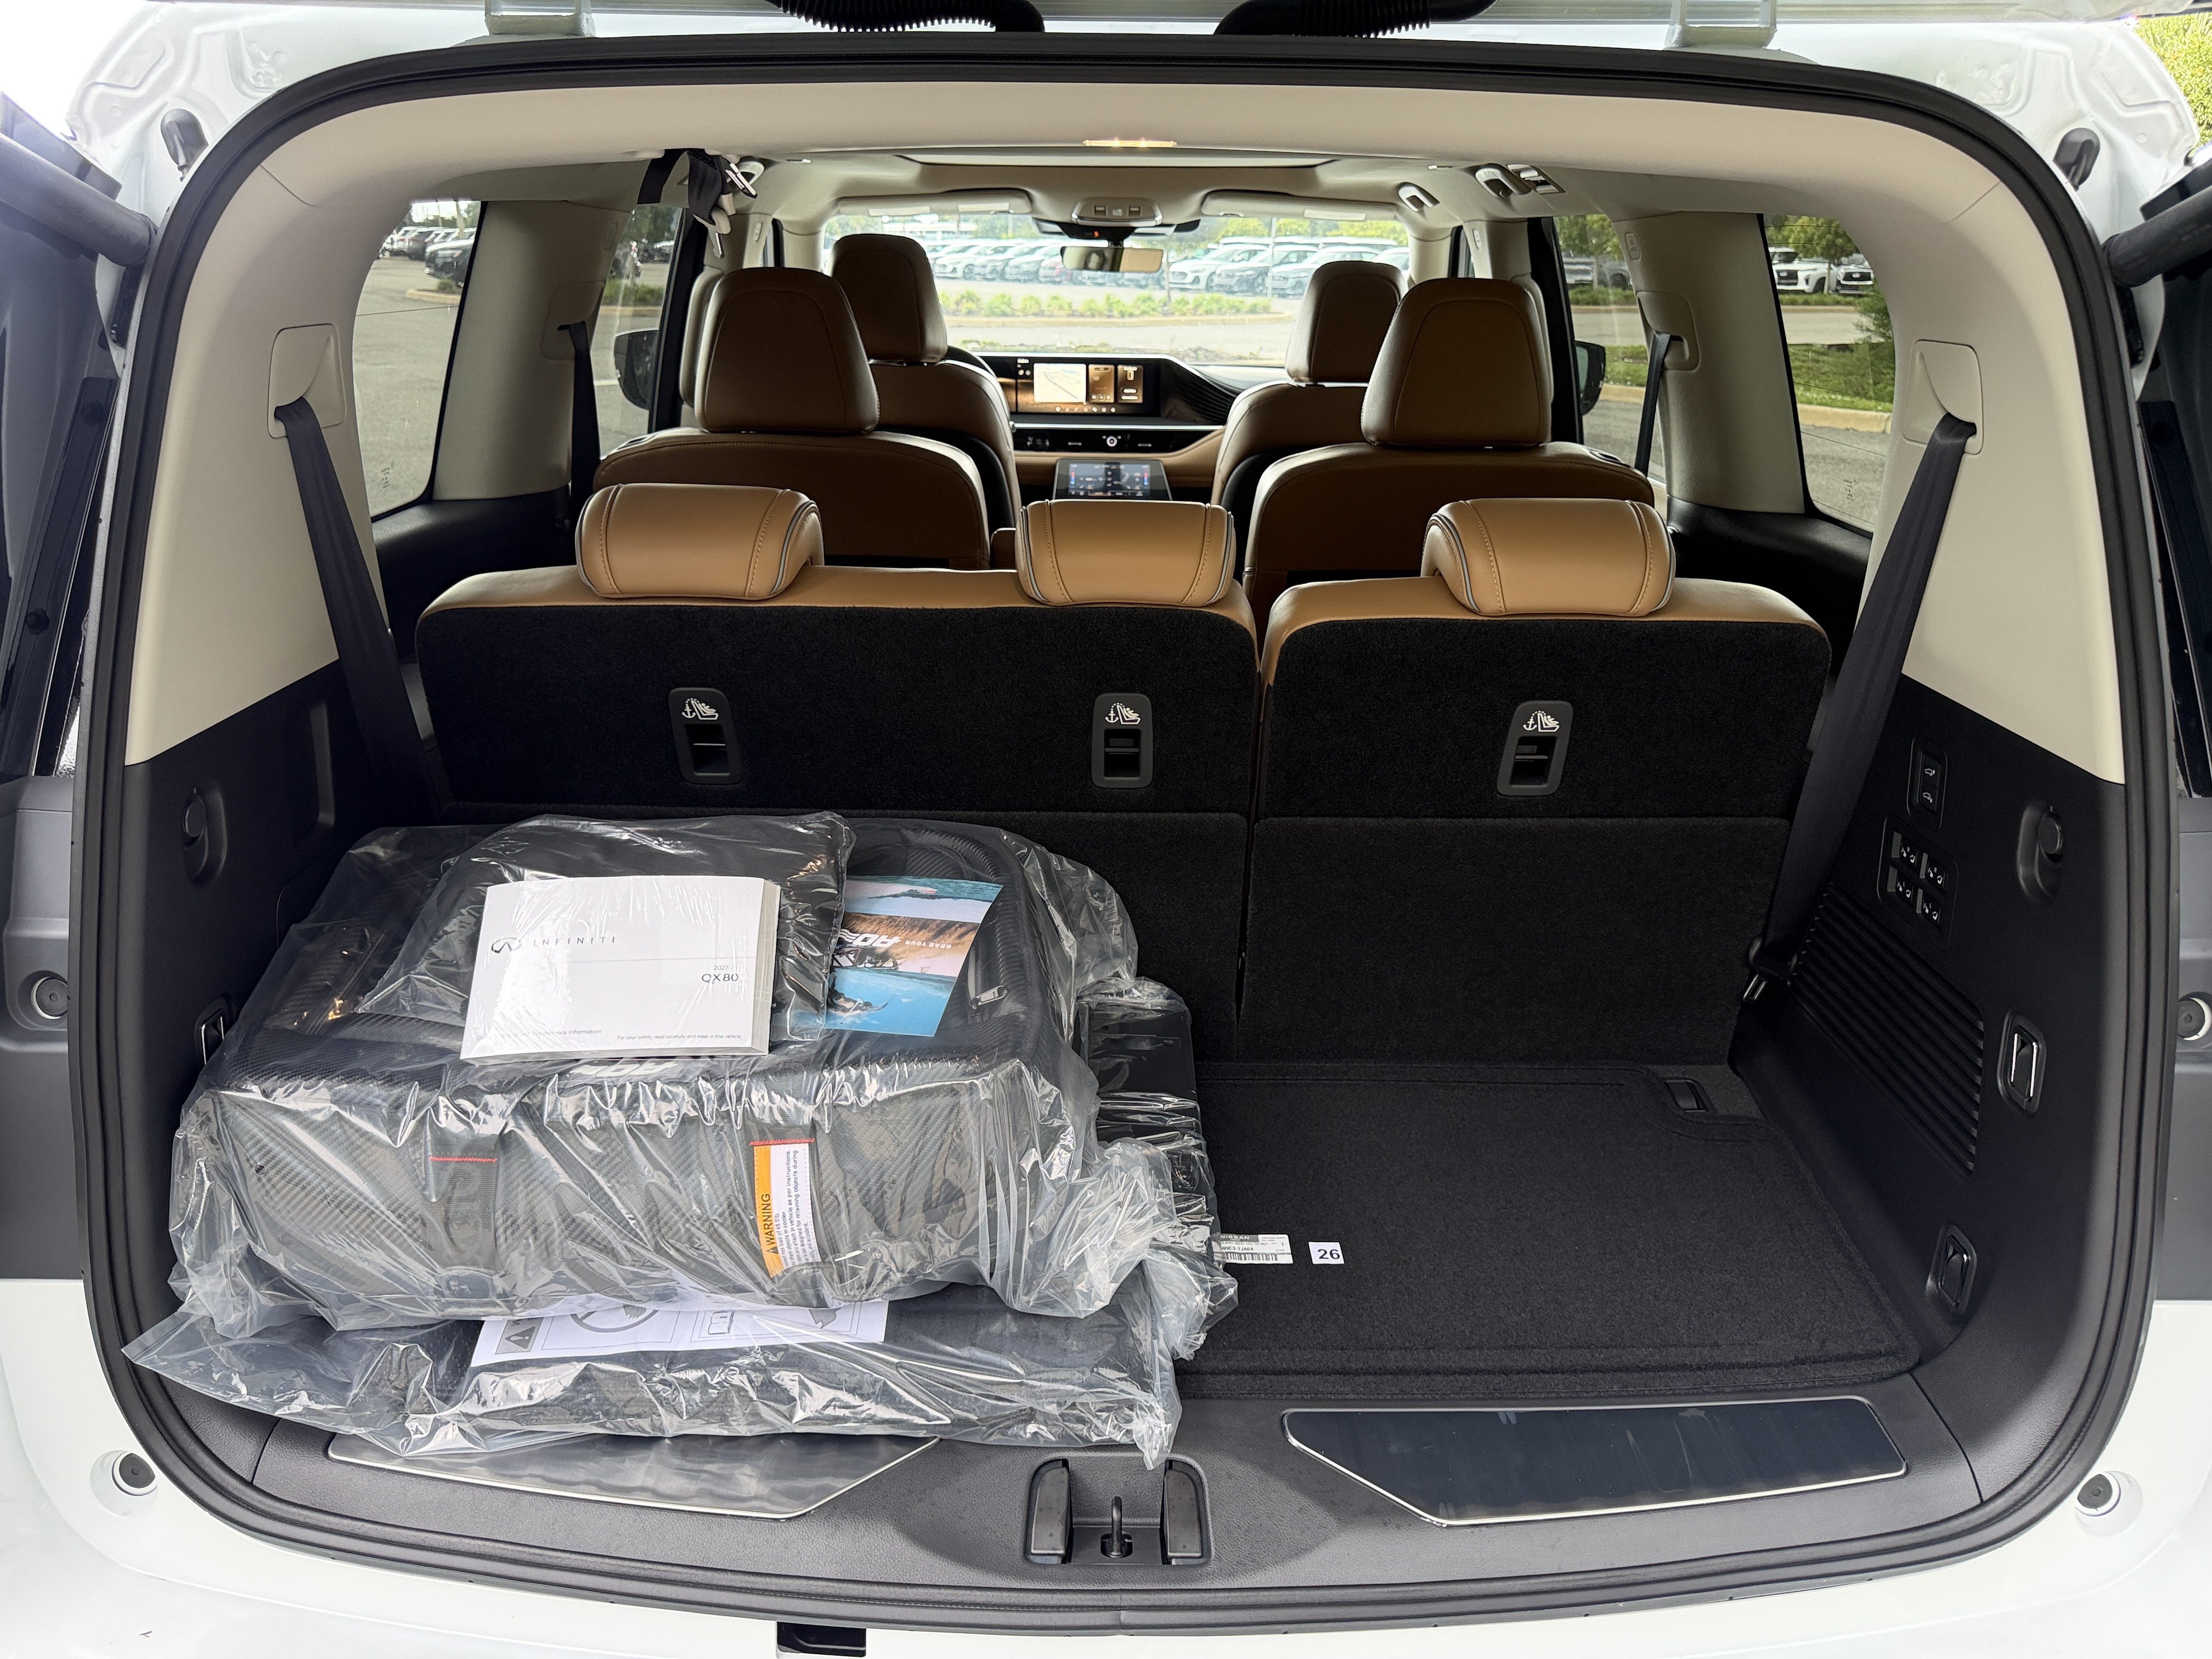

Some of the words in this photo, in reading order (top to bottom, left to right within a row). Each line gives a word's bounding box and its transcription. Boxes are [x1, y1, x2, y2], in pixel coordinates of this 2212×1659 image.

[533, 936, 615, 946] INFINITI
[701, 973, 738, 983] QX80
[761, 1194, 775, 1245] WARNING
[1317, 1249, 1340, 1260] 26
